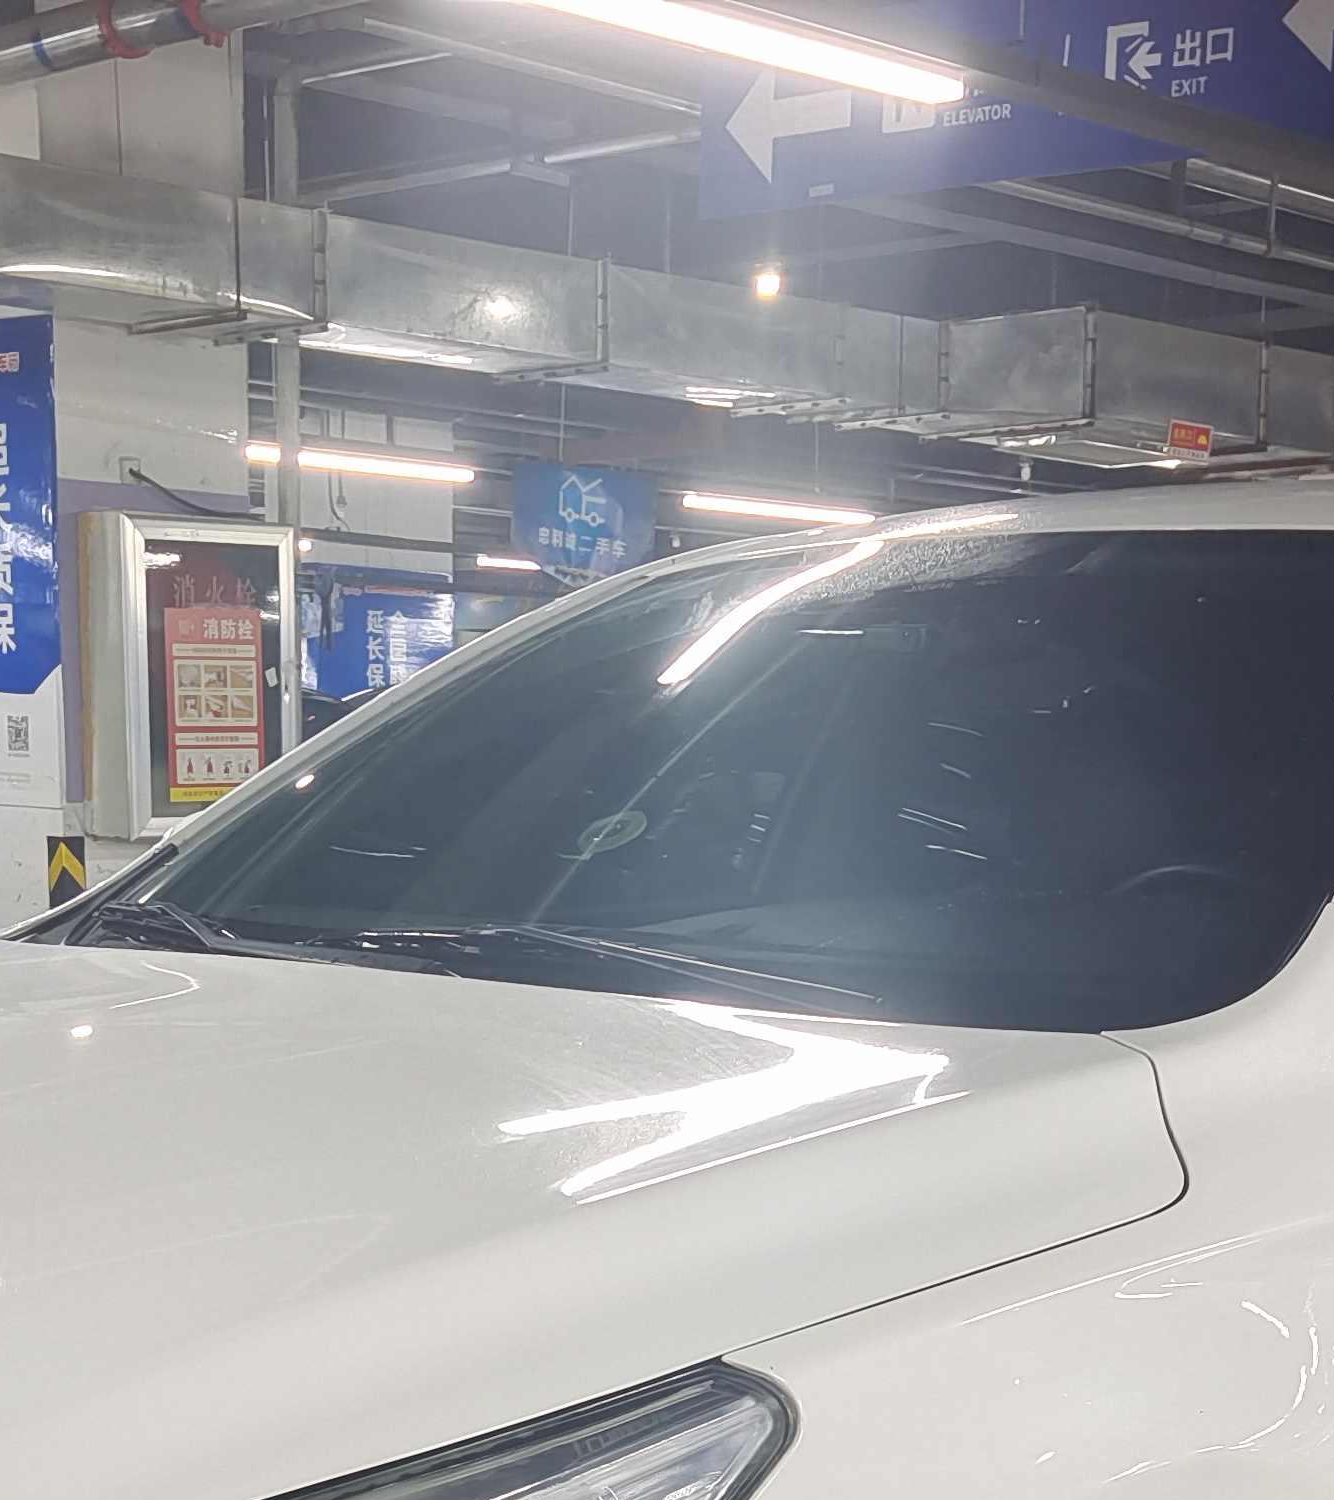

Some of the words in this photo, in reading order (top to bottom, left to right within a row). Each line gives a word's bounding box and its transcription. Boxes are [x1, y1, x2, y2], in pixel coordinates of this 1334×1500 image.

[1172, 27, 1234, 67] 出口
[1171, 77, 1208, 97] EXIT
[943, 103, 1011, 127] ELEVATOR
[203, 618, 255, 640] 消防栓
[366, 609, 385, 687] 延长保
